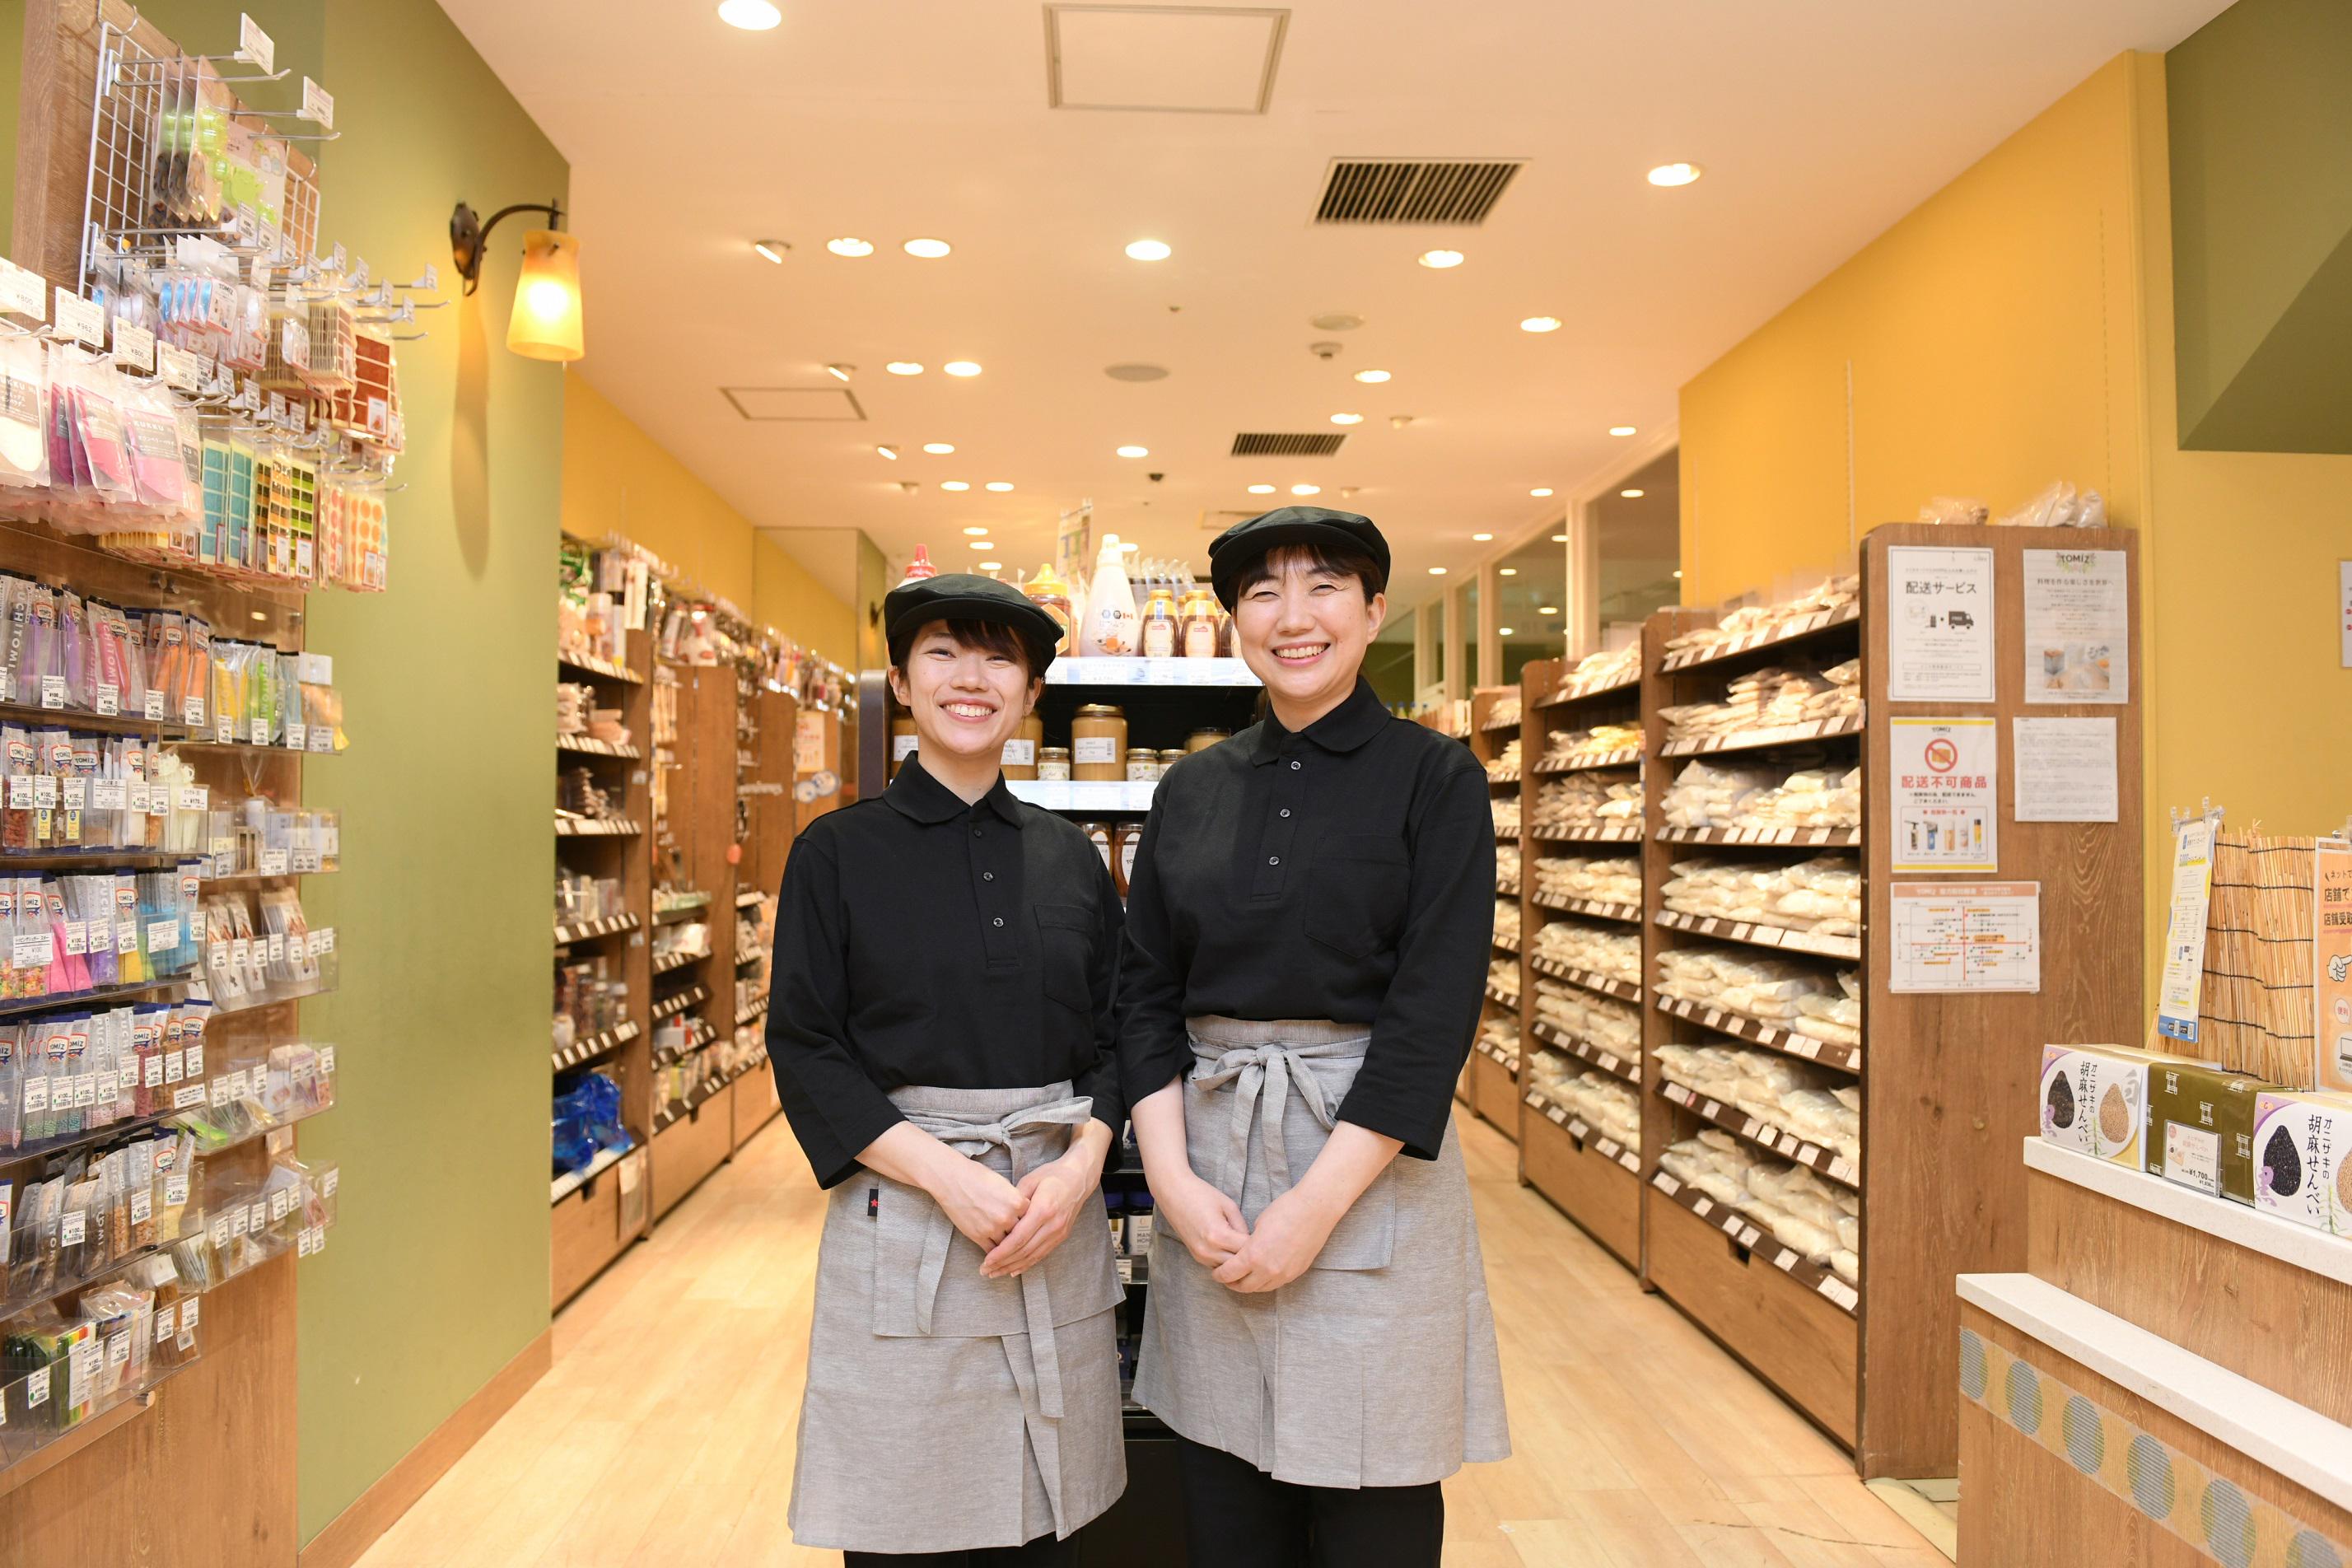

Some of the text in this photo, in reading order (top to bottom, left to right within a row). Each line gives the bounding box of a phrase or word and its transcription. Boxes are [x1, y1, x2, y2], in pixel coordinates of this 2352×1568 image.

[219, 283, 234, 296] TOMIZ
[2060, 554, 2089, 564] TOMIZ
[1906, 581, 1976, 595] 配送サービス
[1902, 777, 1987, 789] 配送不可商品
[2089, 1064, 2098, 1113] オニザキの
[2078, 1061, 2091, 1142] 胡麻せんべい
[2322, 1118, 2333, 1179] オニザキの
[2307, 1114, 2322, 1216] 胡麻せんべい
[2189, 1168, 2208, 1181] ¥1,700
